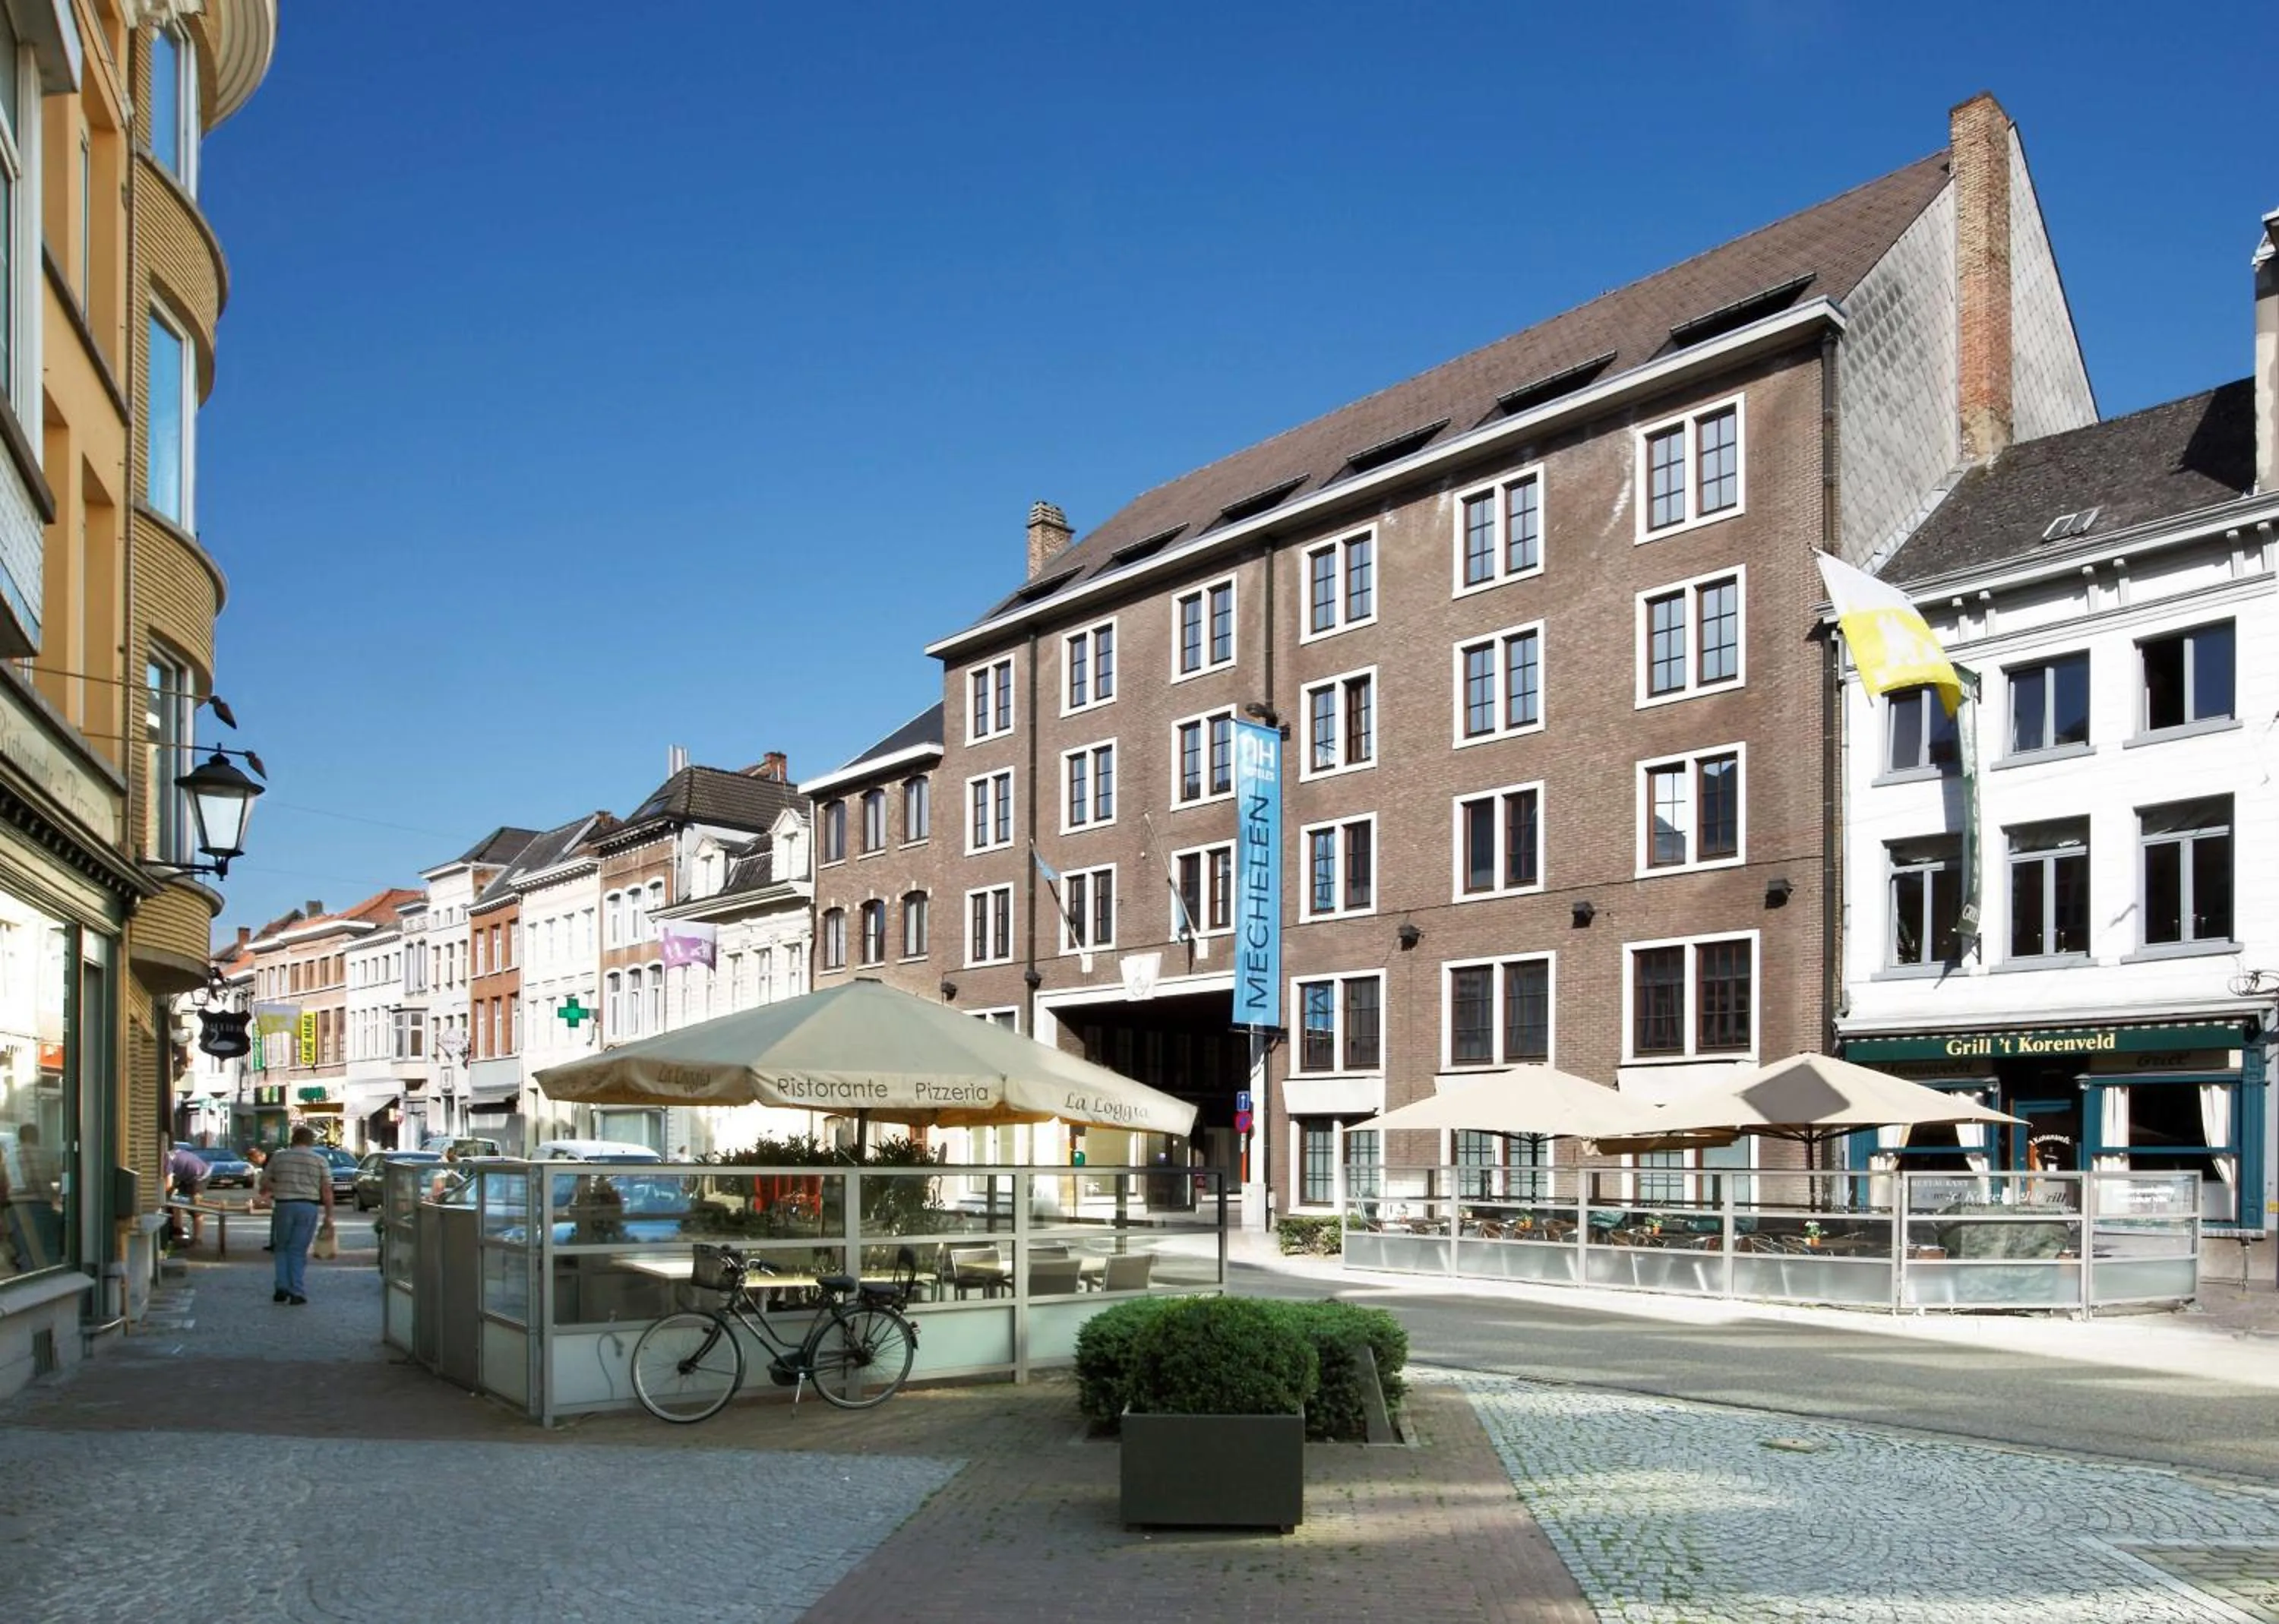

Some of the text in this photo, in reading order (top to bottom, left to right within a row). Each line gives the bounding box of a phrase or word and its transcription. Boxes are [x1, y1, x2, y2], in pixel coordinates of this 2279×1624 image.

[1246, 795, 1269, 1009] MECHELEN
[1946, 1039, 1991, 1055] Grill
[2018, 1034, 2116, 1053] Korenveld
[777, 1078, 988, 1101] Ristorante Pizzeria
[1064, 1092, 1149, 1122] La Loggia
